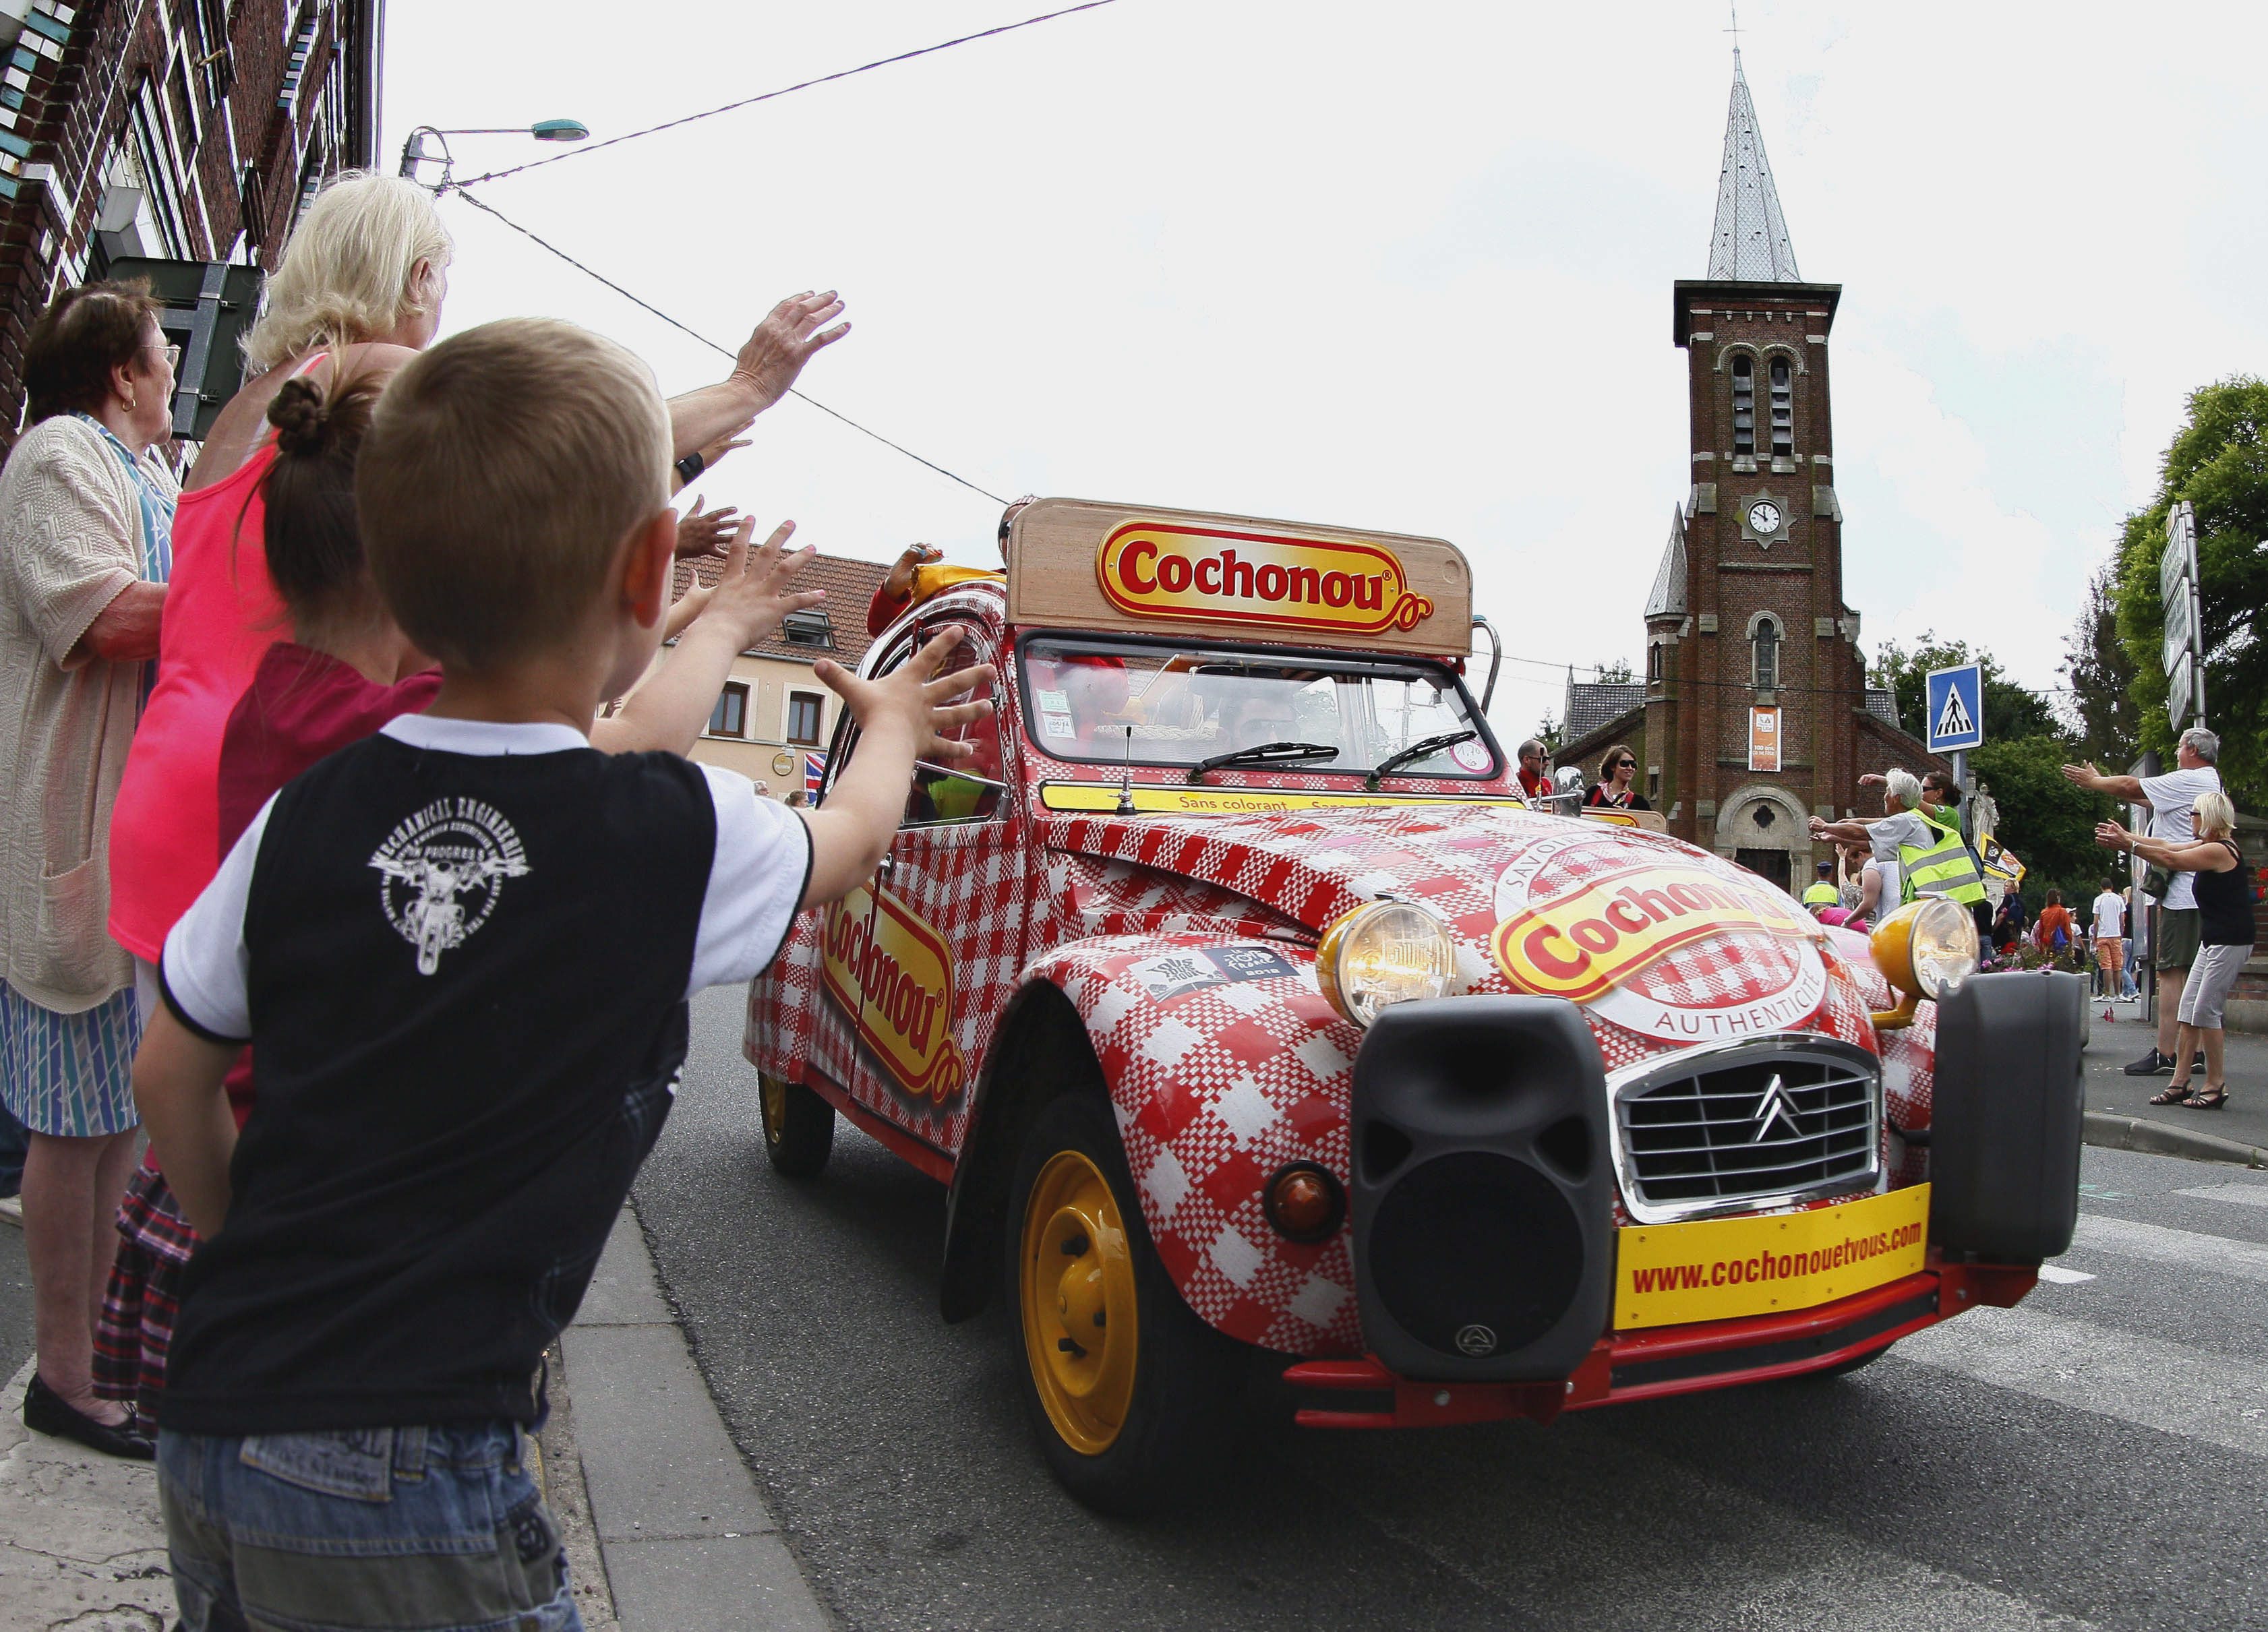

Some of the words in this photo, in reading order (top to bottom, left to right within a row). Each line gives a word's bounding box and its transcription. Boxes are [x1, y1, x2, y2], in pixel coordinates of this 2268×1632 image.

[1179, 796, 1217, 809] Sans
[1223, 798, 1288, 810] colorant
[1632, 1219, 1921, 1294] www.cochonouetvous.com
